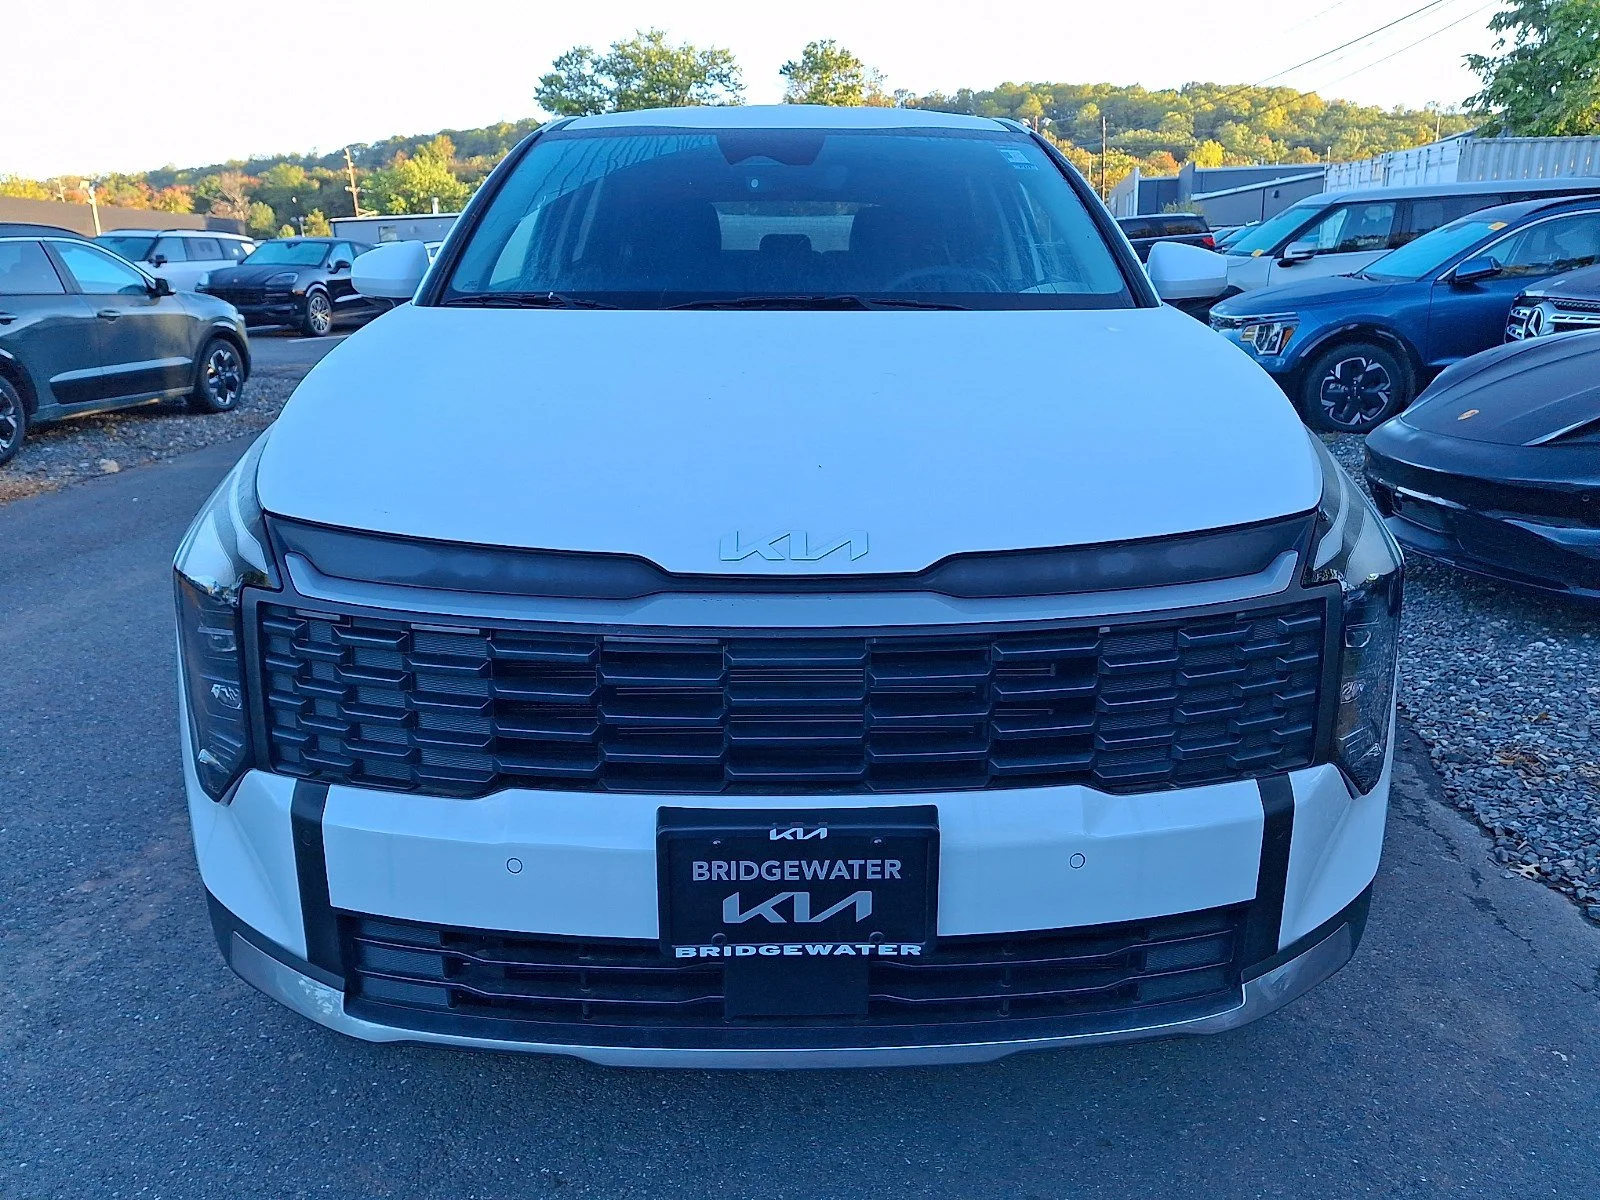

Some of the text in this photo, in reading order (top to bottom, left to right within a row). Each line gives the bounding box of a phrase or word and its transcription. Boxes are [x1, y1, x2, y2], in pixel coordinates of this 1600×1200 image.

[719, 530, 868, 561] KIA
[769, 827, 828, 840] KIA
[692, 859, 902, 881] BRIDGEWATER
[722, 890, 873, 923] KIA
[675, 944, 922, 958] BRIDGEWATER
